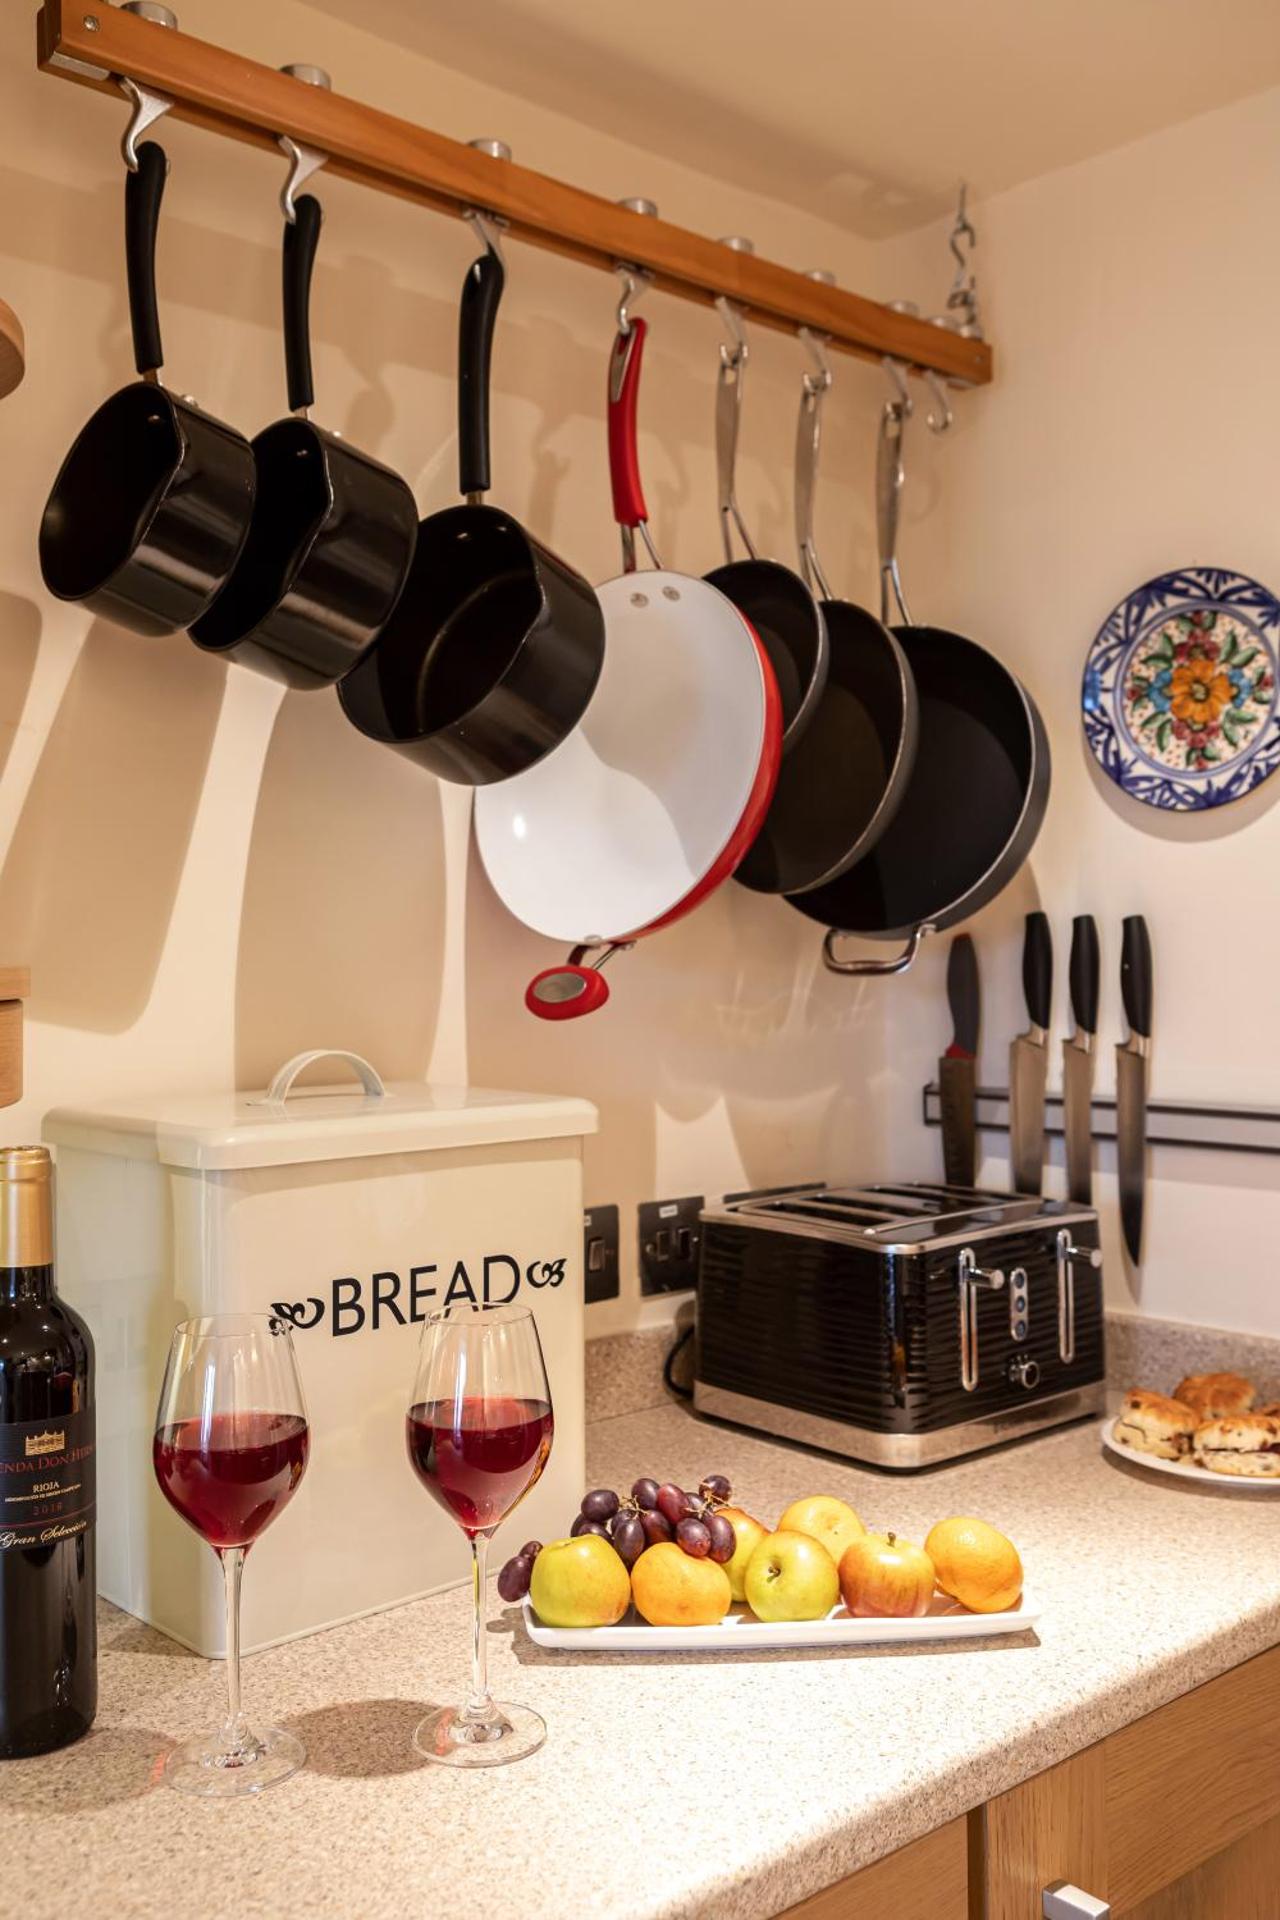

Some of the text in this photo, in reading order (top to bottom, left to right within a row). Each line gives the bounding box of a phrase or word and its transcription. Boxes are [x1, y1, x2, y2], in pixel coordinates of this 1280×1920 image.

[331, 1254, 521, 1337] BREAD
[32, 1481, 60, 1493] RIOJA
[0, 1531, 36, 1549] Gran
